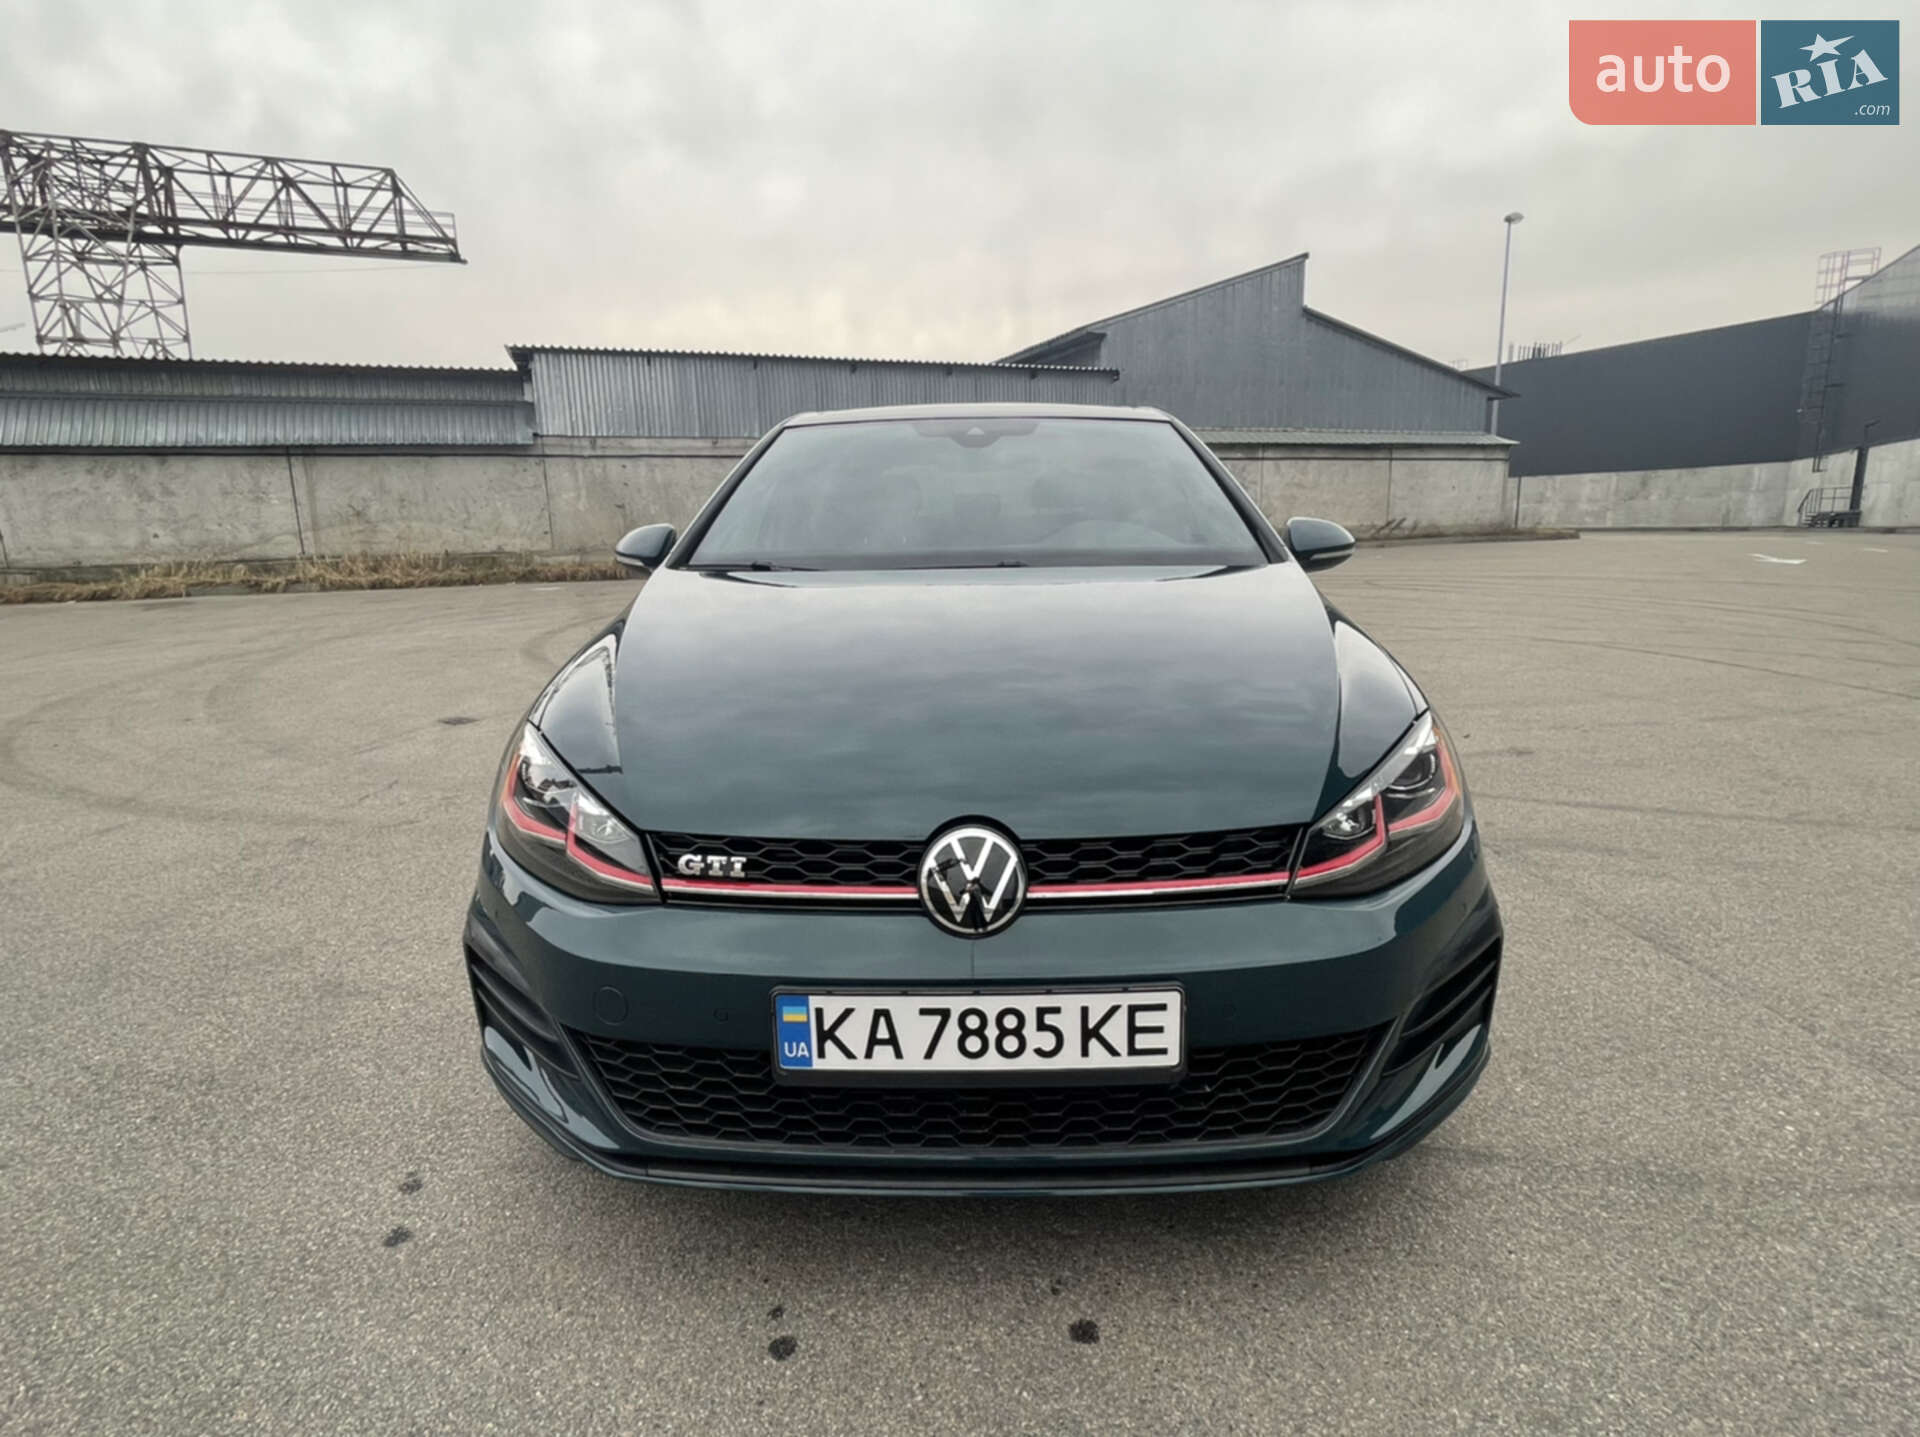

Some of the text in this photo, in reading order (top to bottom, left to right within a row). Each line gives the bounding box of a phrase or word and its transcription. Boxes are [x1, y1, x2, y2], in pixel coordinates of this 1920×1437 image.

[677, 853, 747, 878] GTI
[814, 1003, 1169, 1060] KA 7885 KE
[784, 1041, 810, 1059] UA
